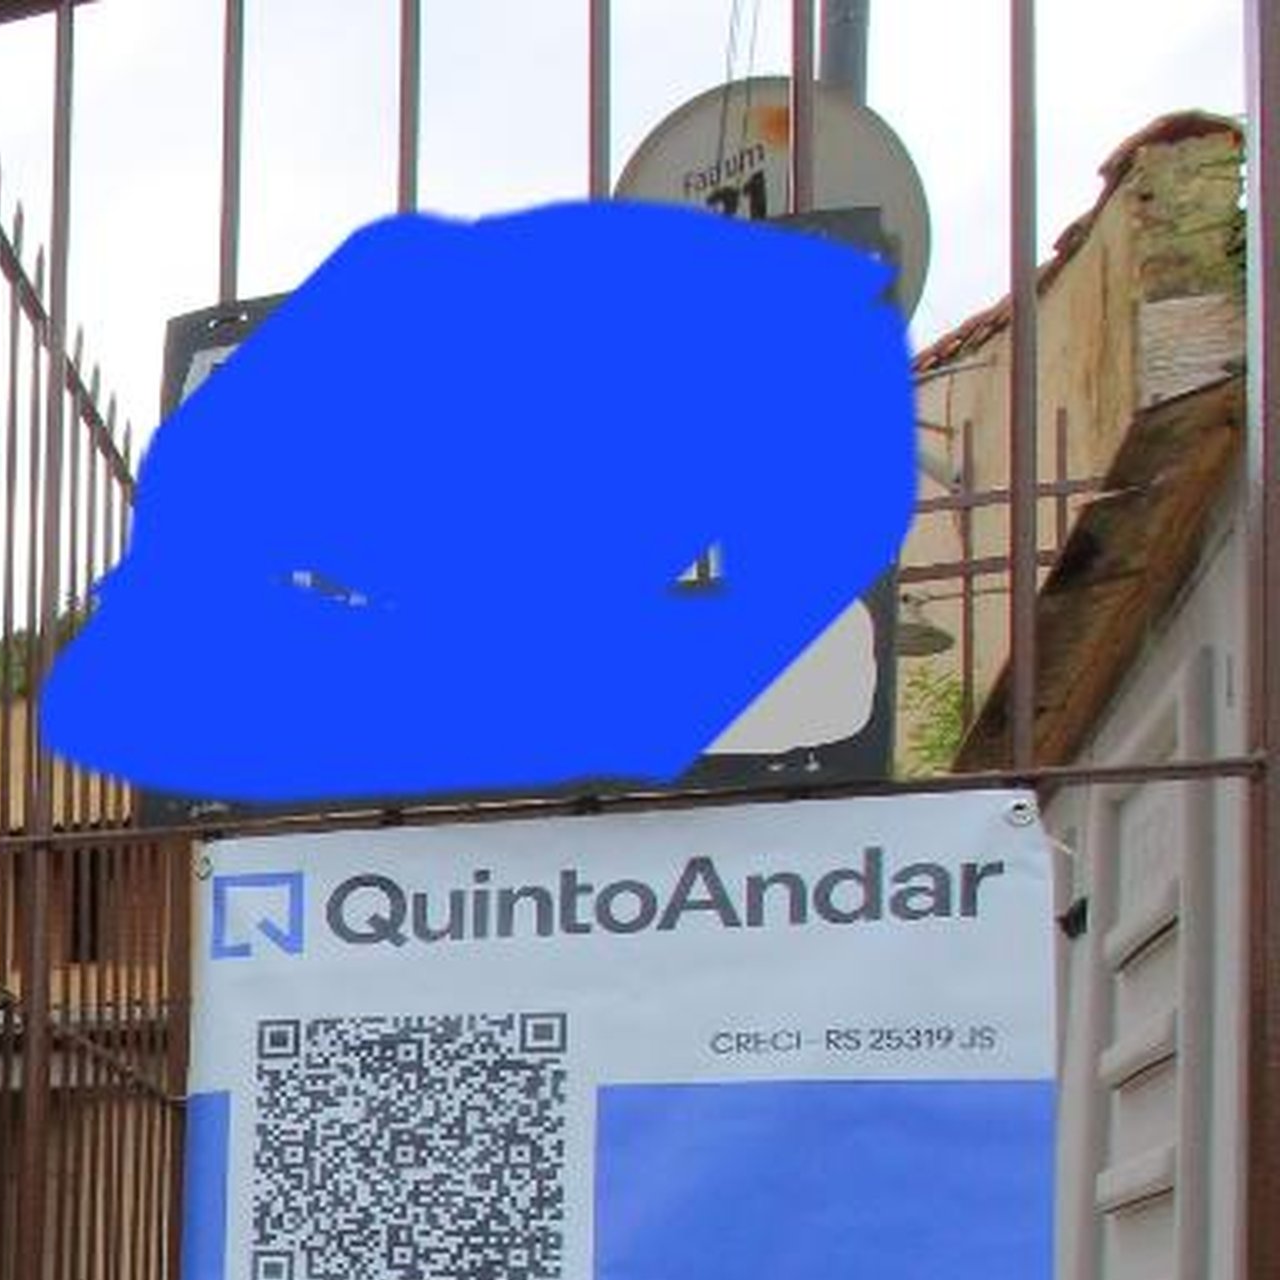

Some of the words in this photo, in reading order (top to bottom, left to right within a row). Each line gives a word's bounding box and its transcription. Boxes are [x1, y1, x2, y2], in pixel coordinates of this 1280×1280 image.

[324, 846, 1006, 948] QuintoAndar
[710, 1030, 802, 1055] CRECI
[825, 1028, 862, 1051] RS
[868, 1026, 955, 1051] 25319
